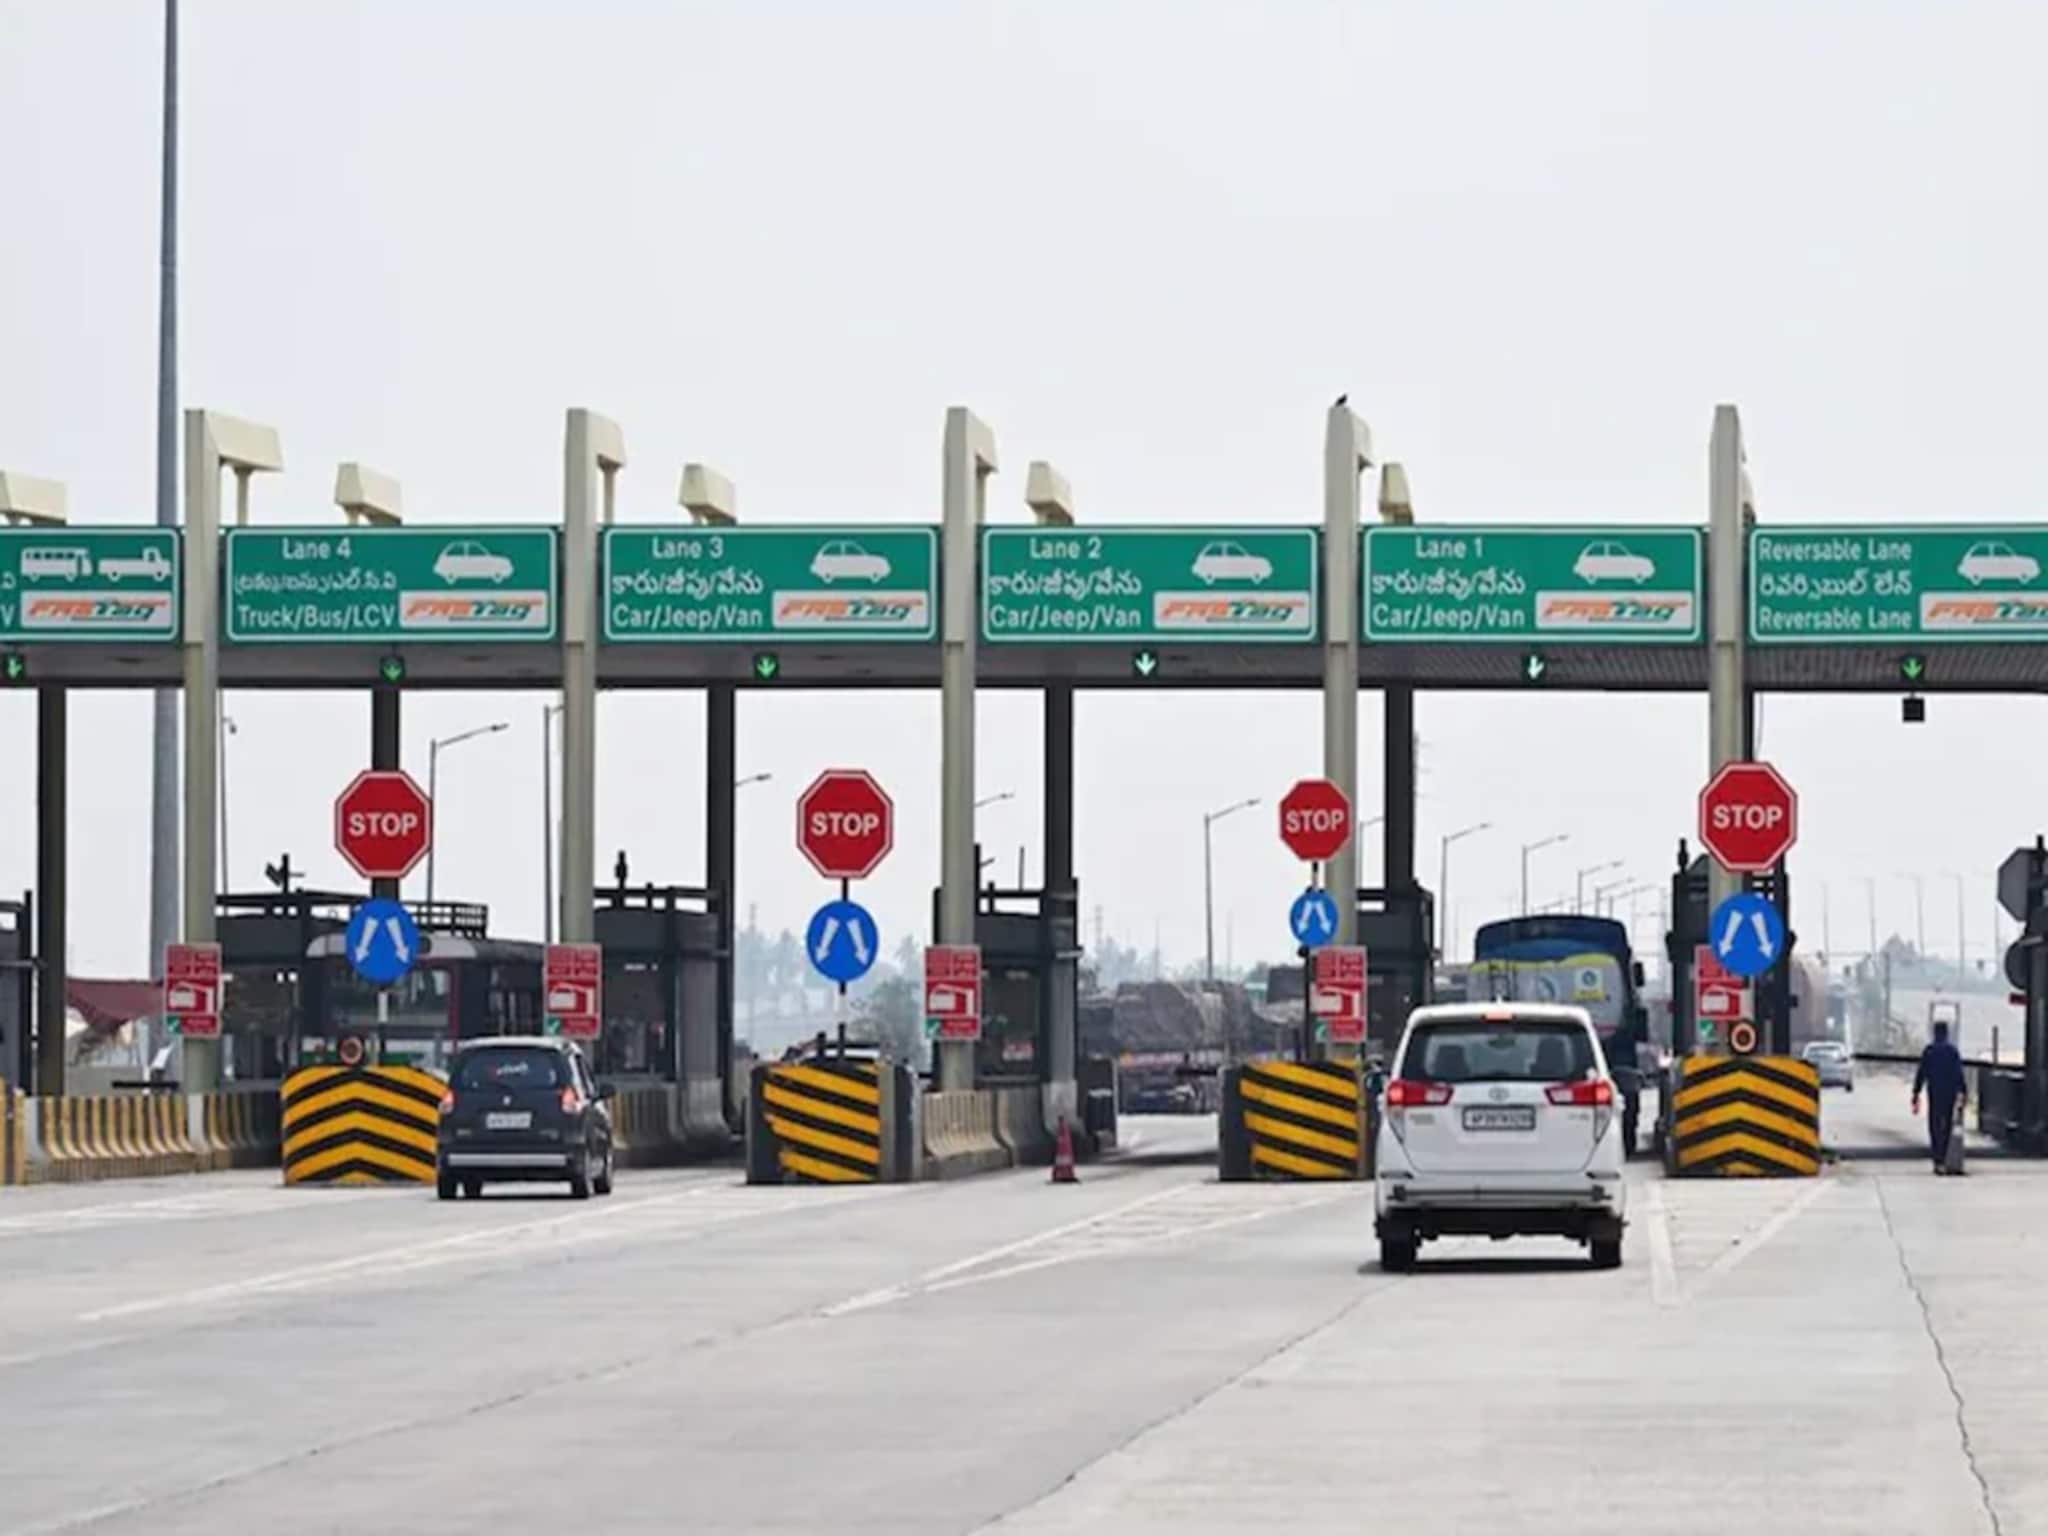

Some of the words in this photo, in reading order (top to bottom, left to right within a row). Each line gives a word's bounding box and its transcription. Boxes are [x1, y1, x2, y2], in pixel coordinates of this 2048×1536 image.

[282, 536, 331, 560] Lane
[336, 536, 352, 559] 4
[652, 536, 703, 560] Lane
[709, 536, 724, 559] 3
[1030, 536, 1081, 560] Lane
[1088, 536, 1102, 559] 2
[1416, 536, 1467, 559] Lane
[1474, 536, 1483, 559] 1
[1759, 537, 1863, 561] Reversable
[1868, 537, 1912, 561] Lane
[237, 604, 396, 631] Truck/Bus/LCV
[612, 603, 764, 631] Car/Jeep/Van
[990, 603, 1142, 631] Car/Jeep/Van
[1372, 603, 1526, 631] Car/Jeep/Van
[1759, 605, 1863, 631] Reversable
[1868, 605, 1912, 630] Lane
[348, 811, 418, 838] STOP
[810, 811, 880, 838] STOP
[1285, 808, 1345, 834] STOP
[1712, 804, 1783, 830] STOP
